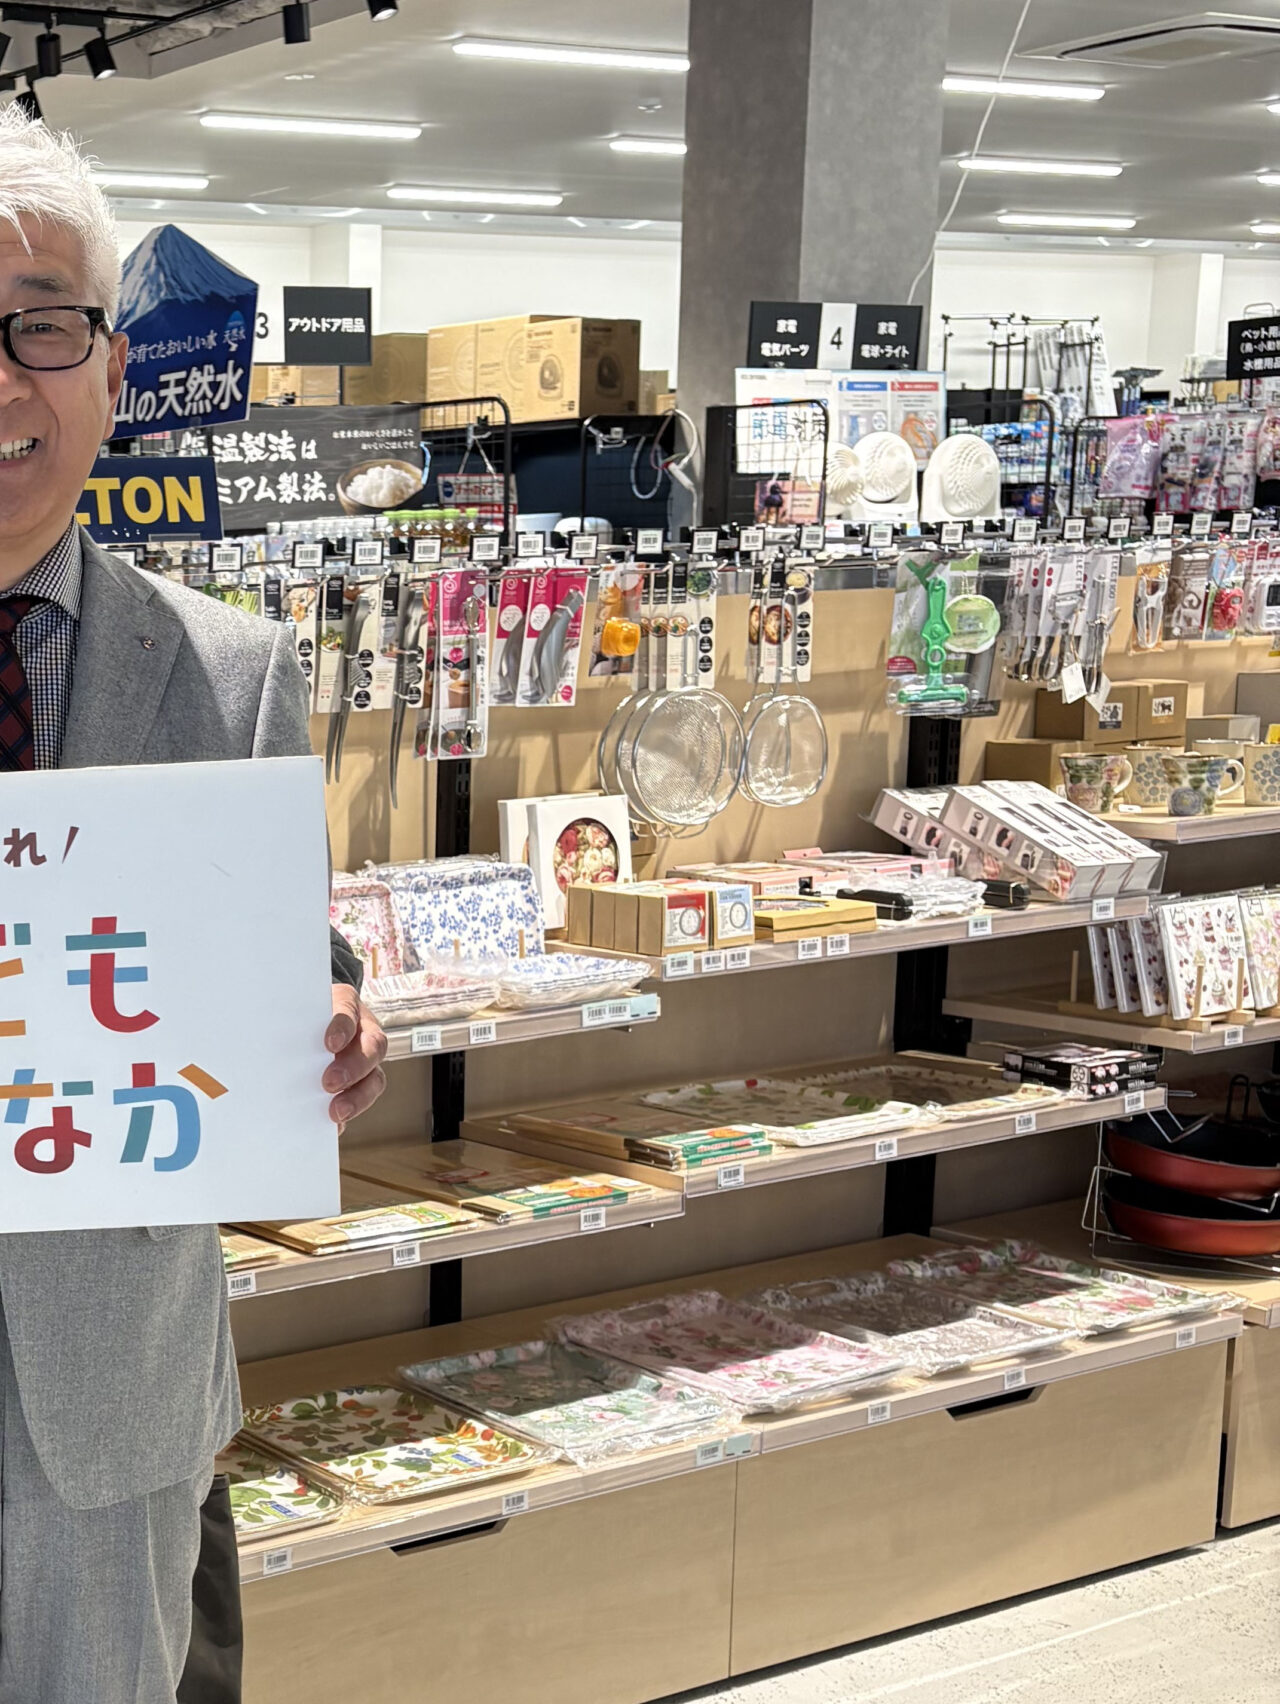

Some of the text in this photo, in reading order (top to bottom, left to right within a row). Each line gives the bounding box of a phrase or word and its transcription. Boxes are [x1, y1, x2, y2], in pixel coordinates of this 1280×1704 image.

[255, 312, 269, 339] 3
[288, 316, 366, 333] アウトドア用品
[776, 319, 798, 334] 家電
[877, 322, 898, 336] 家電
[830, 326, 843, 351] 4
[1241, 326, 1280, 339] ペット用
[761, 343, 810, 357] 電気パーツ
[860, 344, 910, 359] 電球・ライト
[75, 476, 205, 525] TON
